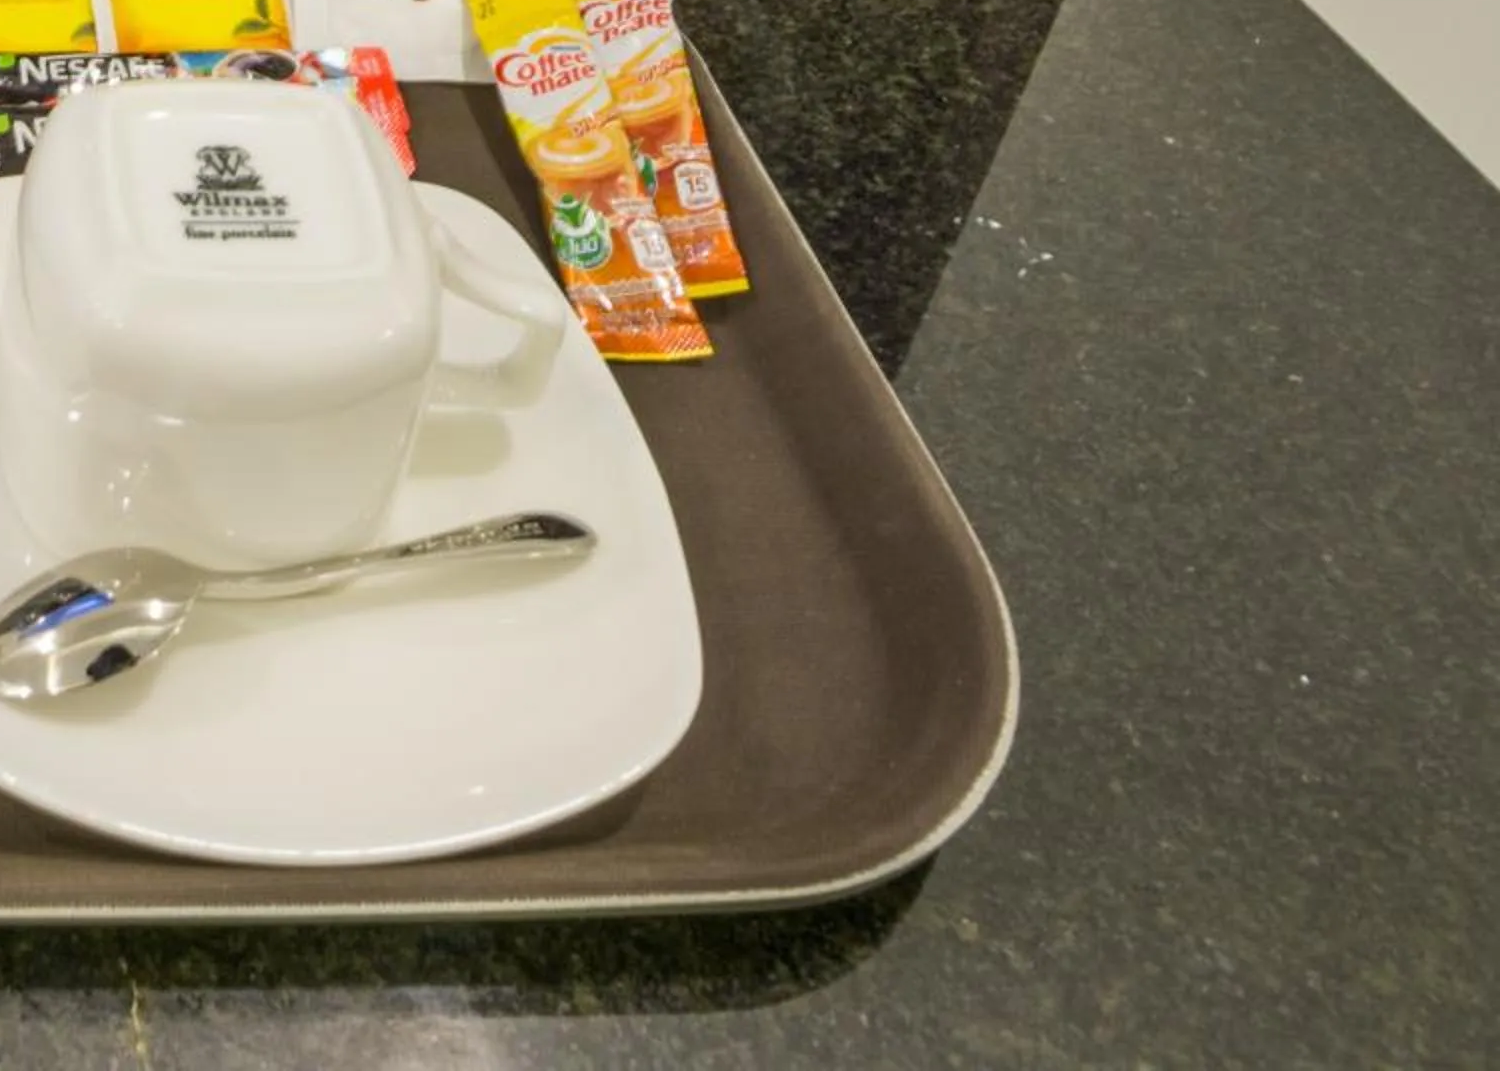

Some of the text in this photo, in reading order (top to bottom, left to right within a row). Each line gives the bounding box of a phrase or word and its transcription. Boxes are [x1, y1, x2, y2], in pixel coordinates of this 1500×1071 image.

[495, 50, 587, 87] Coffee
[531, 65, 596, 96] mate
[173, 192, 288, 207] Wilmax
